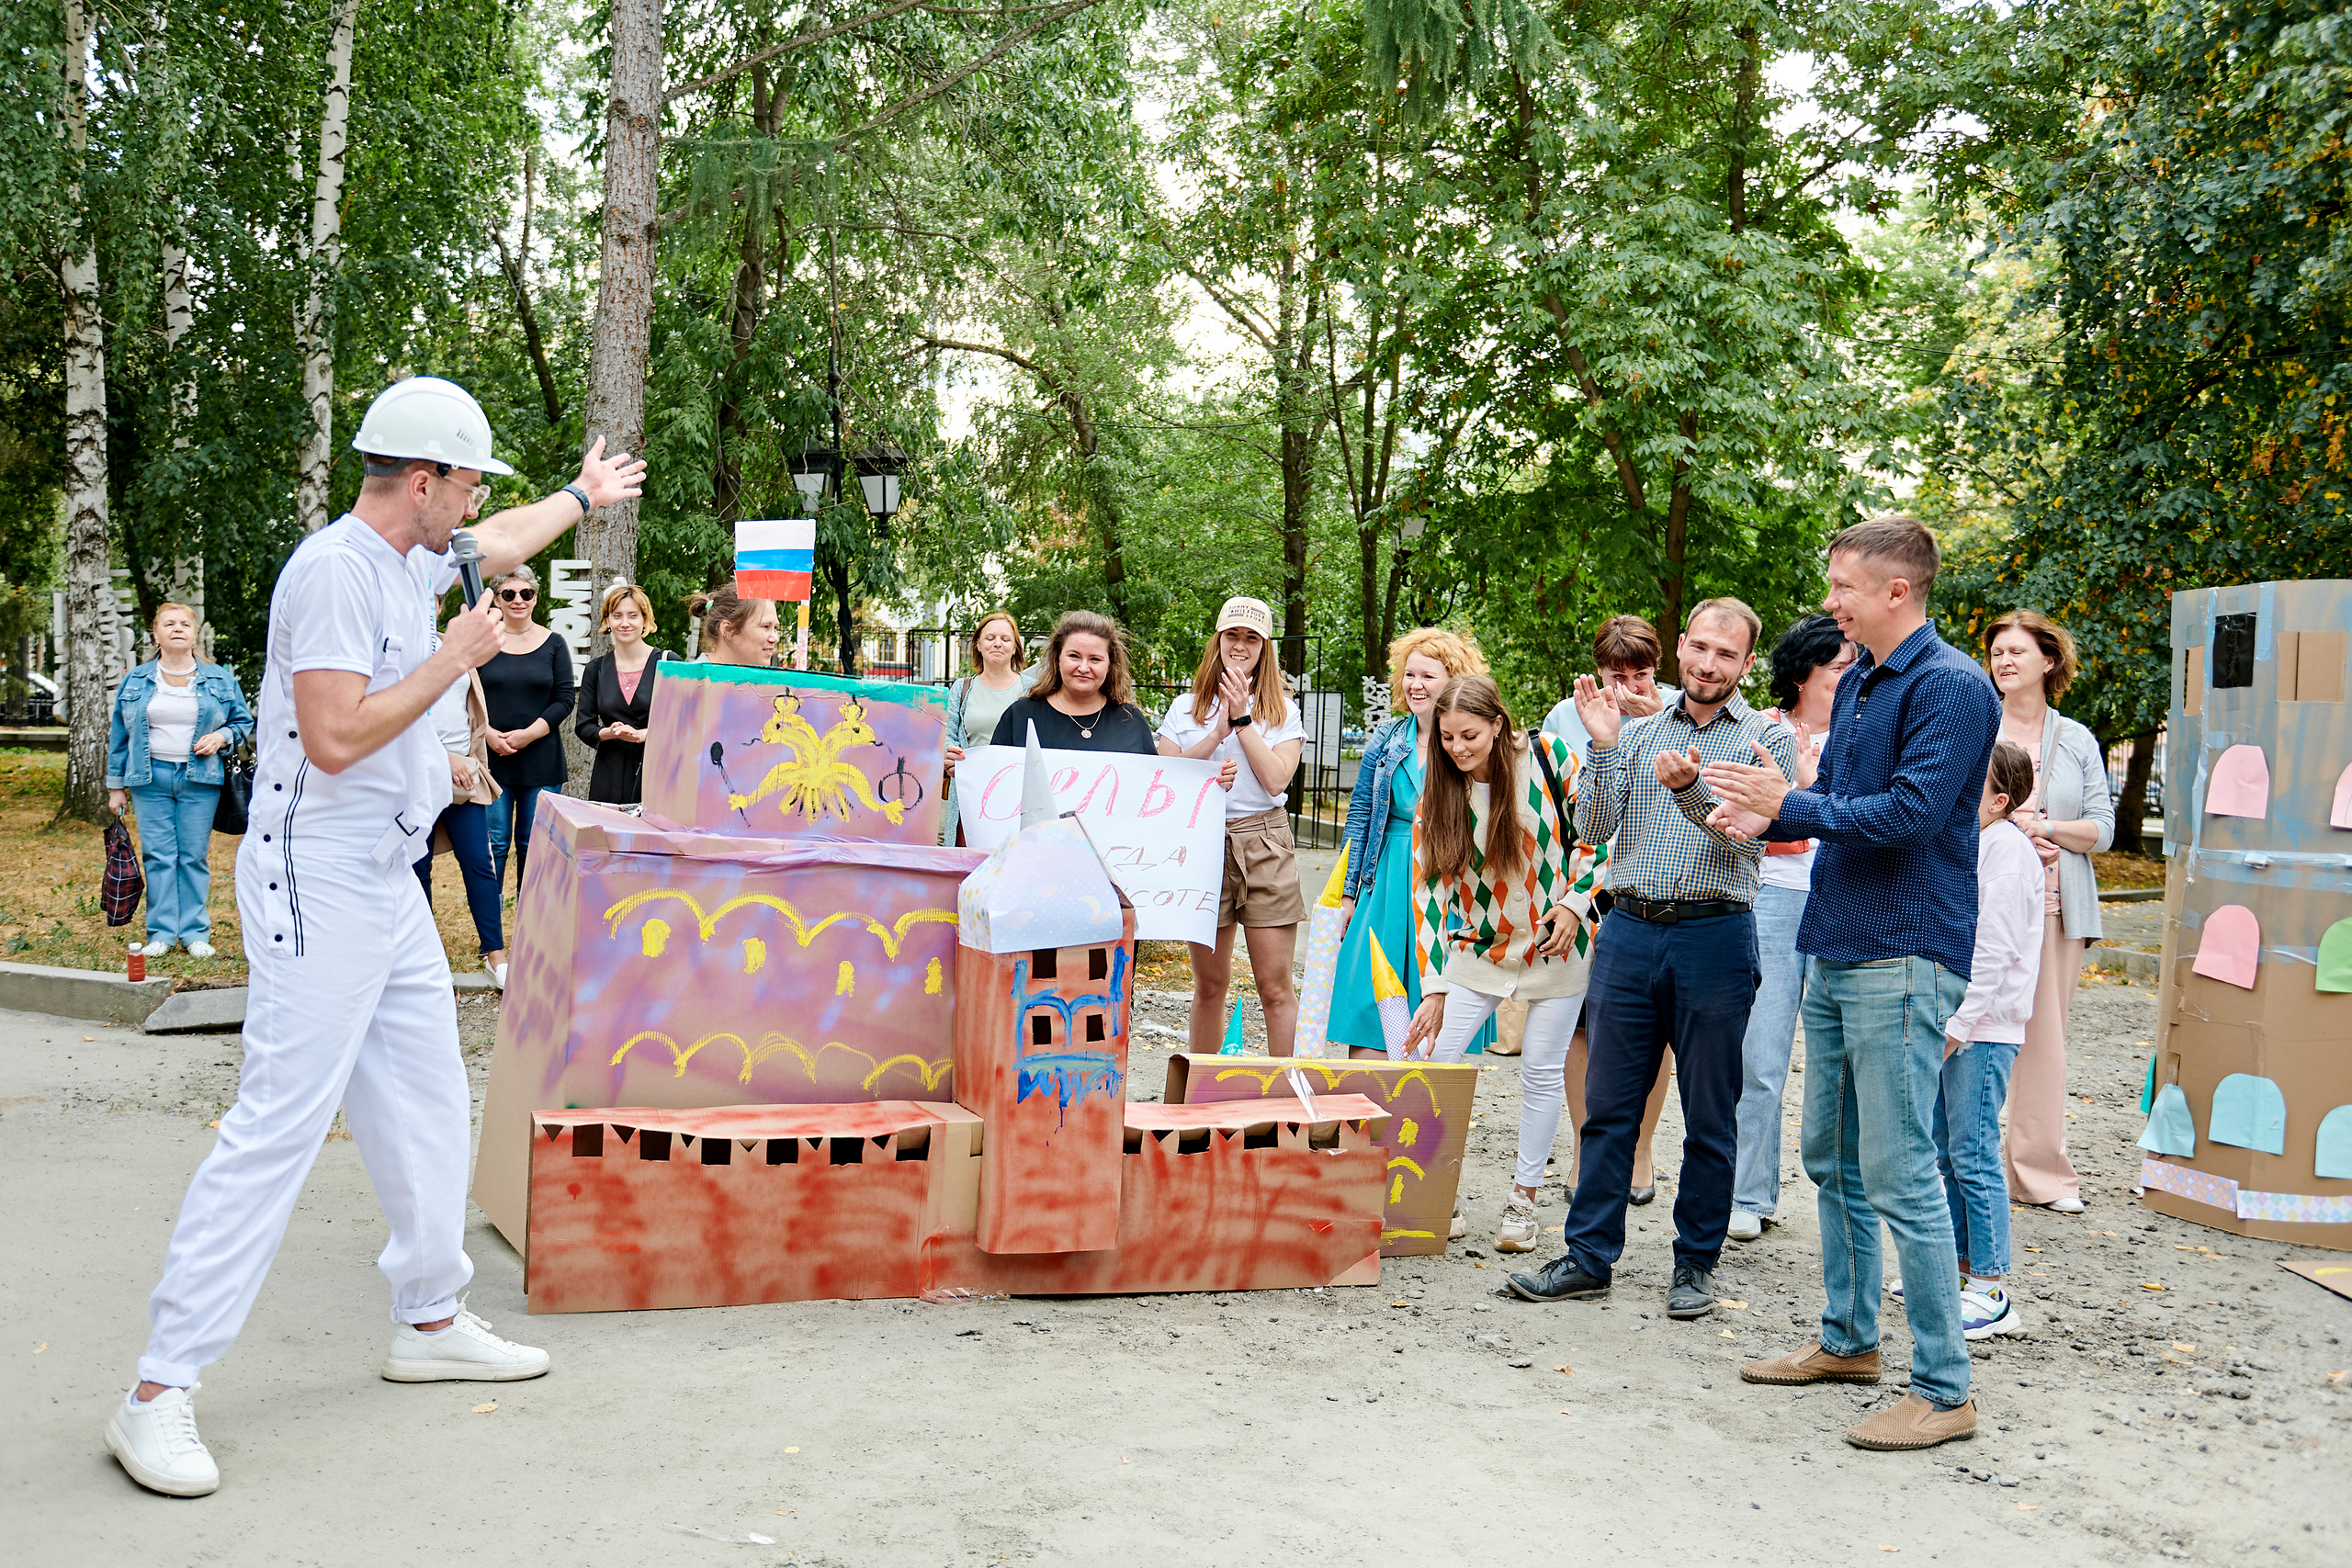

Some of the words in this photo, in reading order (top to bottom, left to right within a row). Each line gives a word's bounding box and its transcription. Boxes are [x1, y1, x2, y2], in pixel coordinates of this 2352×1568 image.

[1235, 609, 1265, 619] HILFIGER
[1246, 615, 1264, 624] SPORT
[1376, 682, 1392, 721] ИЗМА
[1104, 845, 1188, 872] ГДА
[1125, 886, 1217, 916] СОТЕ
